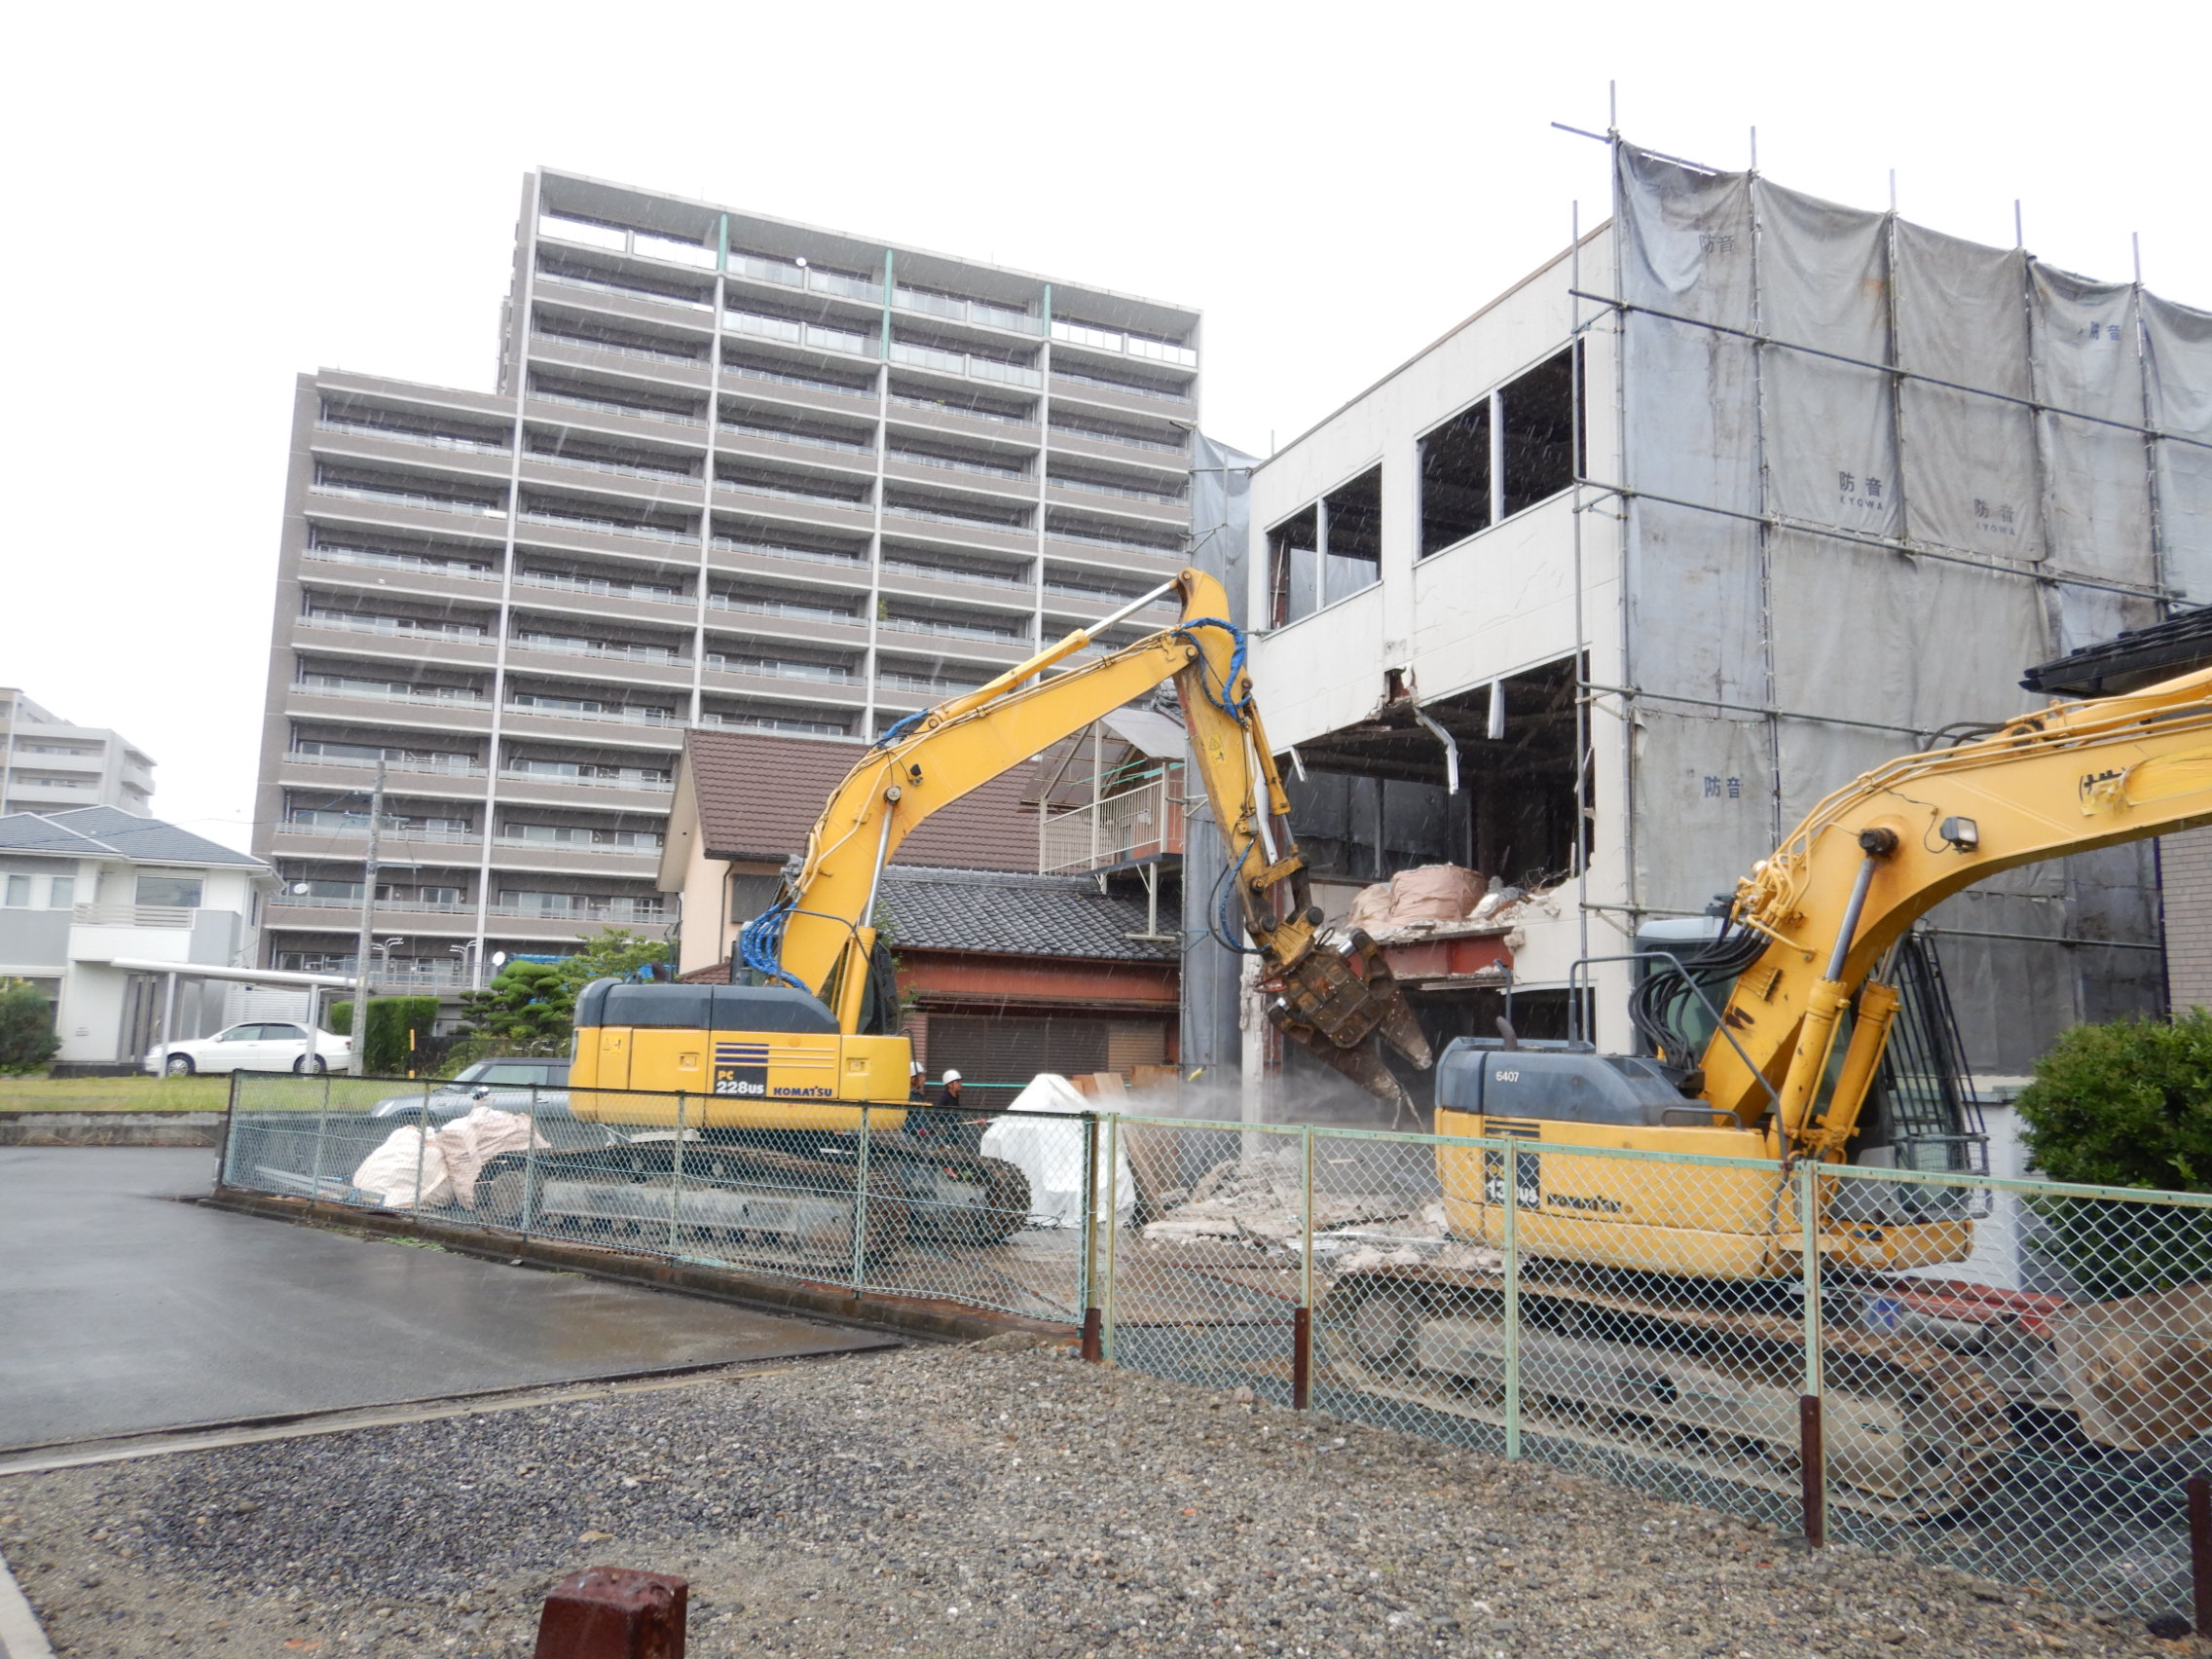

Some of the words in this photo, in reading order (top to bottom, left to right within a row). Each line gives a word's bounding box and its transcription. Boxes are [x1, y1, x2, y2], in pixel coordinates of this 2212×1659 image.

[1699, 234, 1734, 253] 防音
[1839, 471, 1882, 497] 防音
[1840, 497, 1883, 510] KYOWA
[1973, 498, 2014, 523] 防音
[1704, 775, 1740, 798] 防音
[718, 1070, 734, 1081] PC
[1495, 1070, 1520, 1083] 6407
[716, 1081, 764, 1094] 228US
[773, 1086, 832, 1096] KOMATSU
